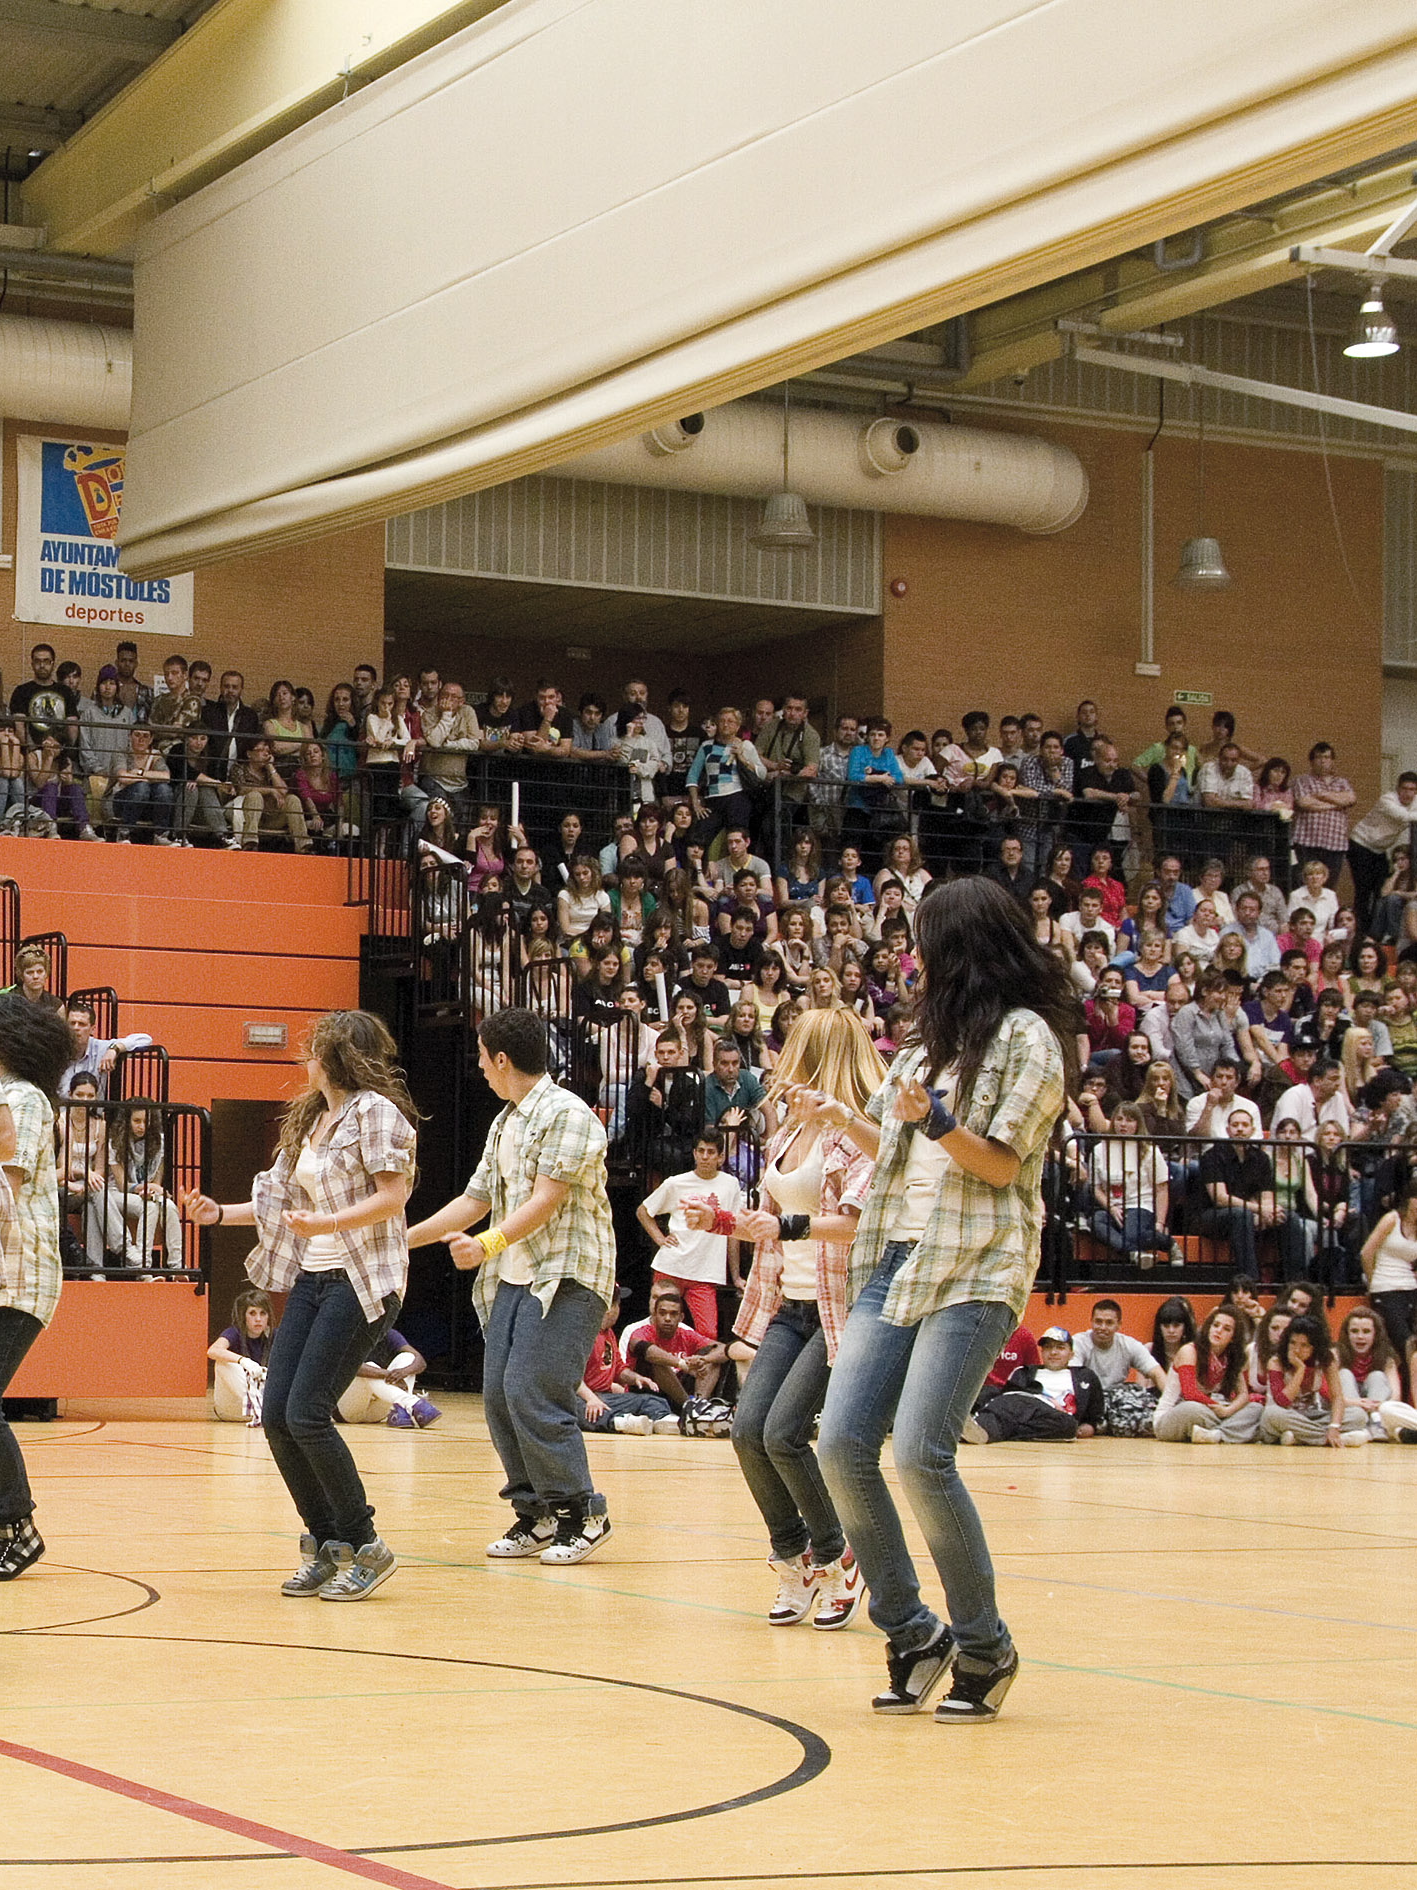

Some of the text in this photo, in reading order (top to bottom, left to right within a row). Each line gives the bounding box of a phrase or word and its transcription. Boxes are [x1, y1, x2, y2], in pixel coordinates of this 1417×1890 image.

[40, 539, 121, 568] AYUNTAM
[40, 566, 171, 604] DE MÓSTOLES
[65, 602, 145, 624] deportes
